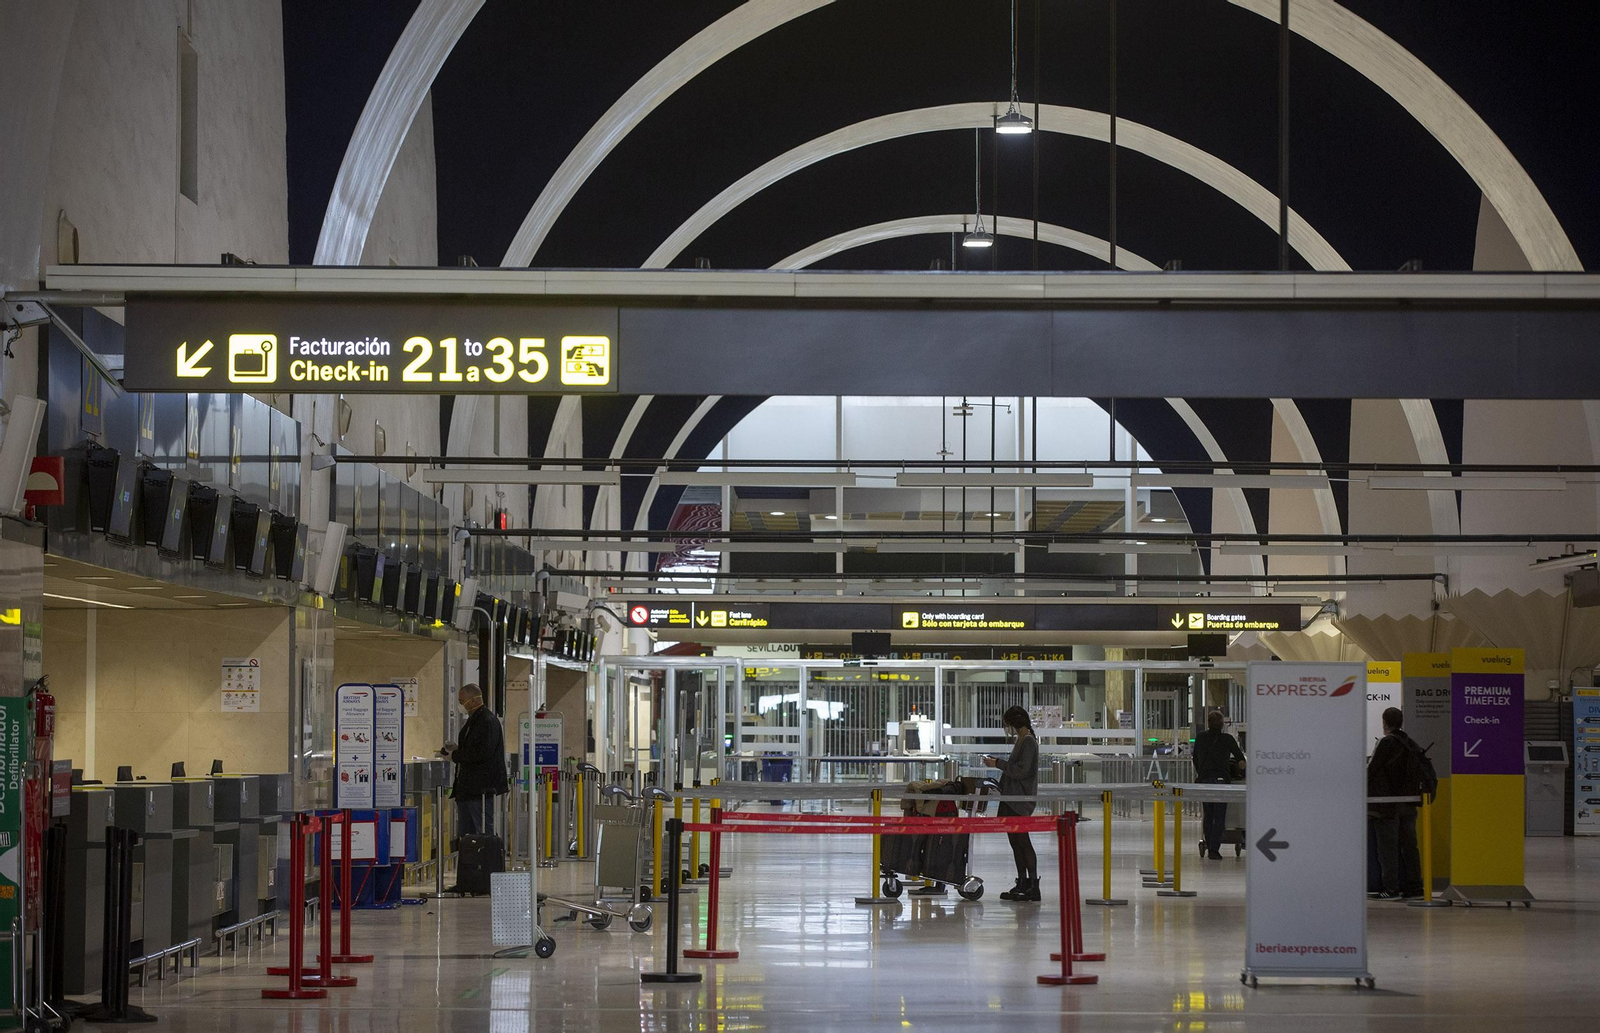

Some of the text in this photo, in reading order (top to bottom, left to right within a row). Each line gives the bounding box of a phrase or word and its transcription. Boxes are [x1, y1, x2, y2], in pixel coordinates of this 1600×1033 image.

[289, 336, 391, 356] Facturación
[402, 336, 549, 382] 21 to 35
[289, 360, 390, 382] Check-in
[466, 366, 480, 382] a
[1206, 613, 1246, 622] Boarding gates
[952, 620, 977, 629] tarjeta
[978, 620, 988, 628] de
[988, 620, 1025, 629] embarque
[1244, 621, 1279, 629] embarque
[1481, 655, 1511, 666] vueling
[1256, 684, 1328, 696] EXPRESS
[1415, 689, 1433, 697] BAG
[1464, 686, 1511, 696] PREMIUM
[1464, 696, 1511, 706] TIMEFLEX
[1464, 715, 1500, 724] Check-in
[9, 719, 20, 790] Defibrillator
[1255, 750, 1311, 760] Facturación
[1255, 765, 1295, 775] Check-in
[1255, 943, 1357, 956] iberiaexpress.com
